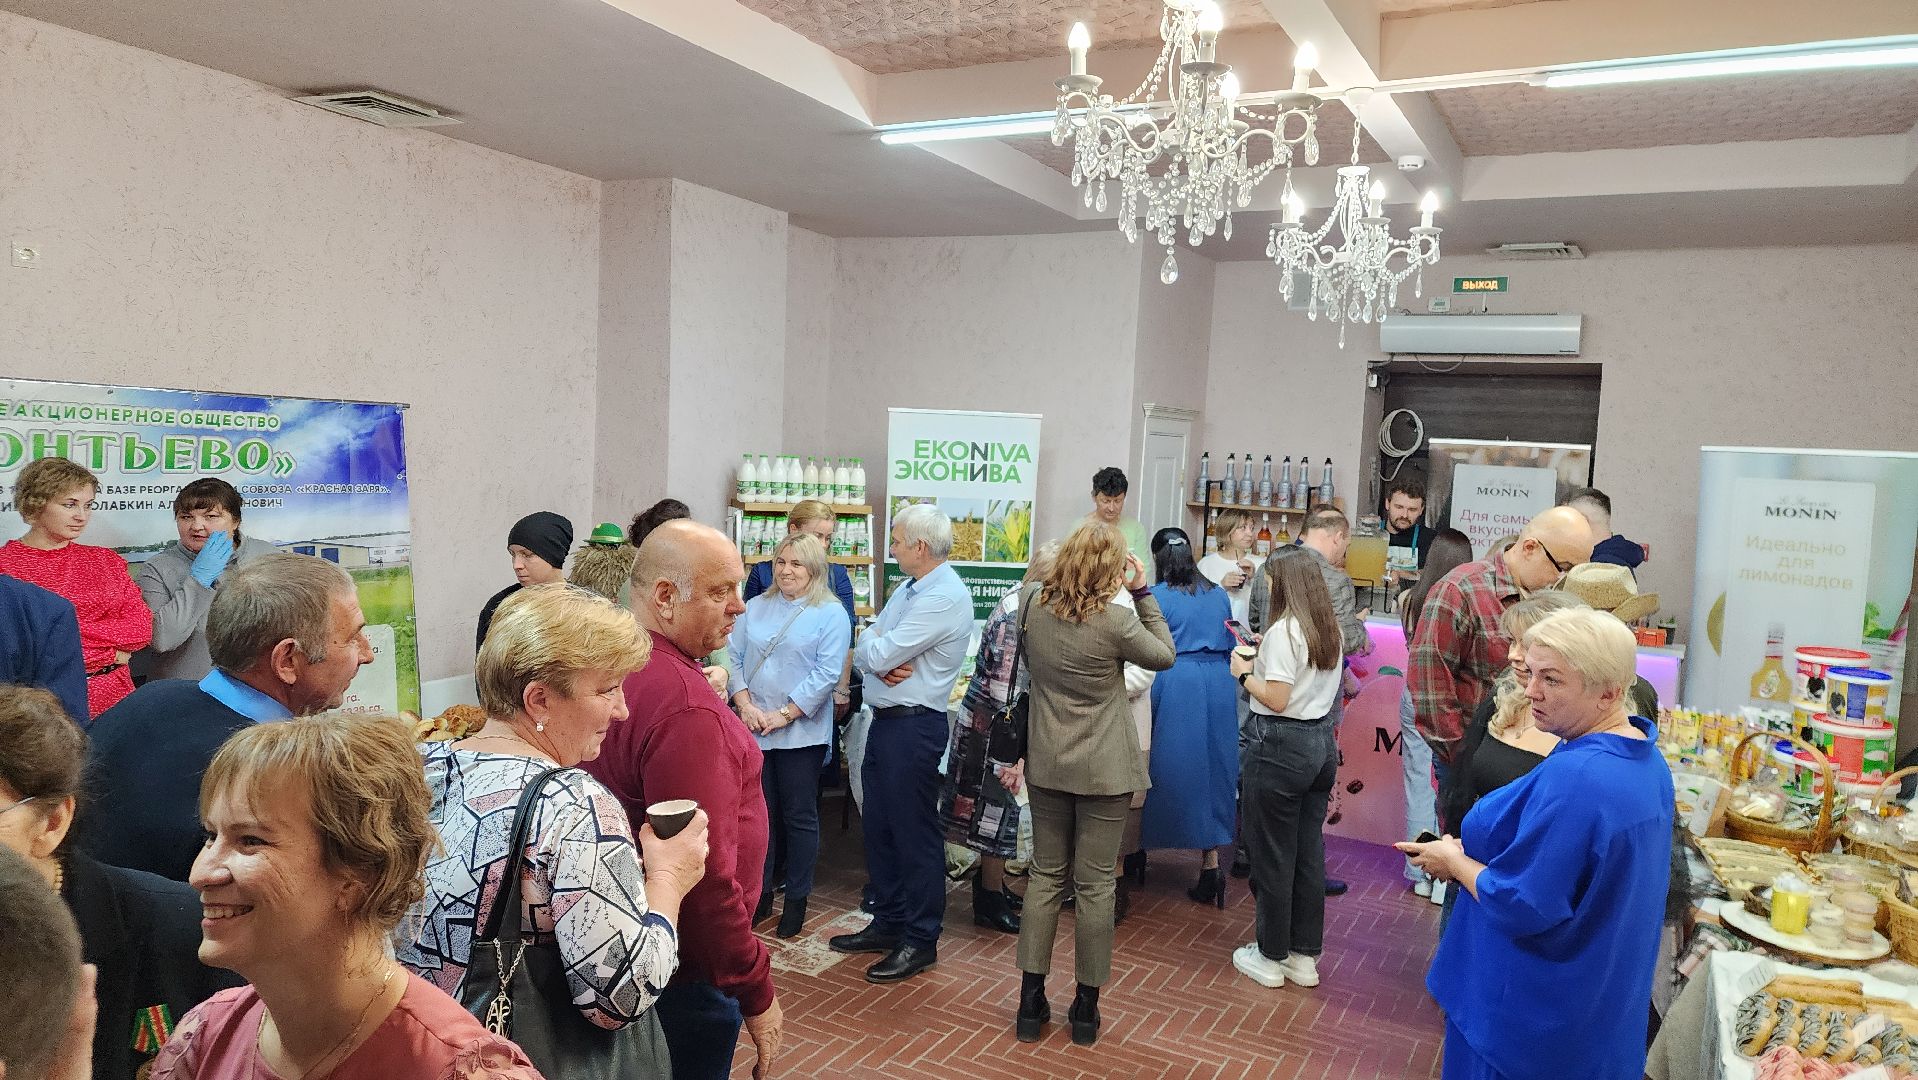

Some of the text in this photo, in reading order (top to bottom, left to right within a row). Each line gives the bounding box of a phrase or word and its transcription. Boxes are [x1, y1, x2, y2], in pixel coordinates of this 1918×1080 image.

[1462, 280, 1498, 290] ВЫХОД
[13, 403, 175, 423] АКЦИОНЕРНОЕ
[180, 411, 279, 428] ОБЩЕСТВО
[914, 439, 1032, 463] EKONIVA
[894, 460, 1022, 483] ЭКОНИВА
[107, 486, 136, 494] БАЗЕ
[242, 485, 292, 494] СОВХОЗА
[1476, 486, 1529, 498] MONIN
[91, 500, 153, 510] ОЛАБКИН
[1460, 509, 1489, 523] Для
[1765, 505, 1837, 520] MONIN
[1744, 536, 1846, 556] Идеально
[1777, 556, 1815, 569] для
[1739, 568, 1854, 590] лимонадов
